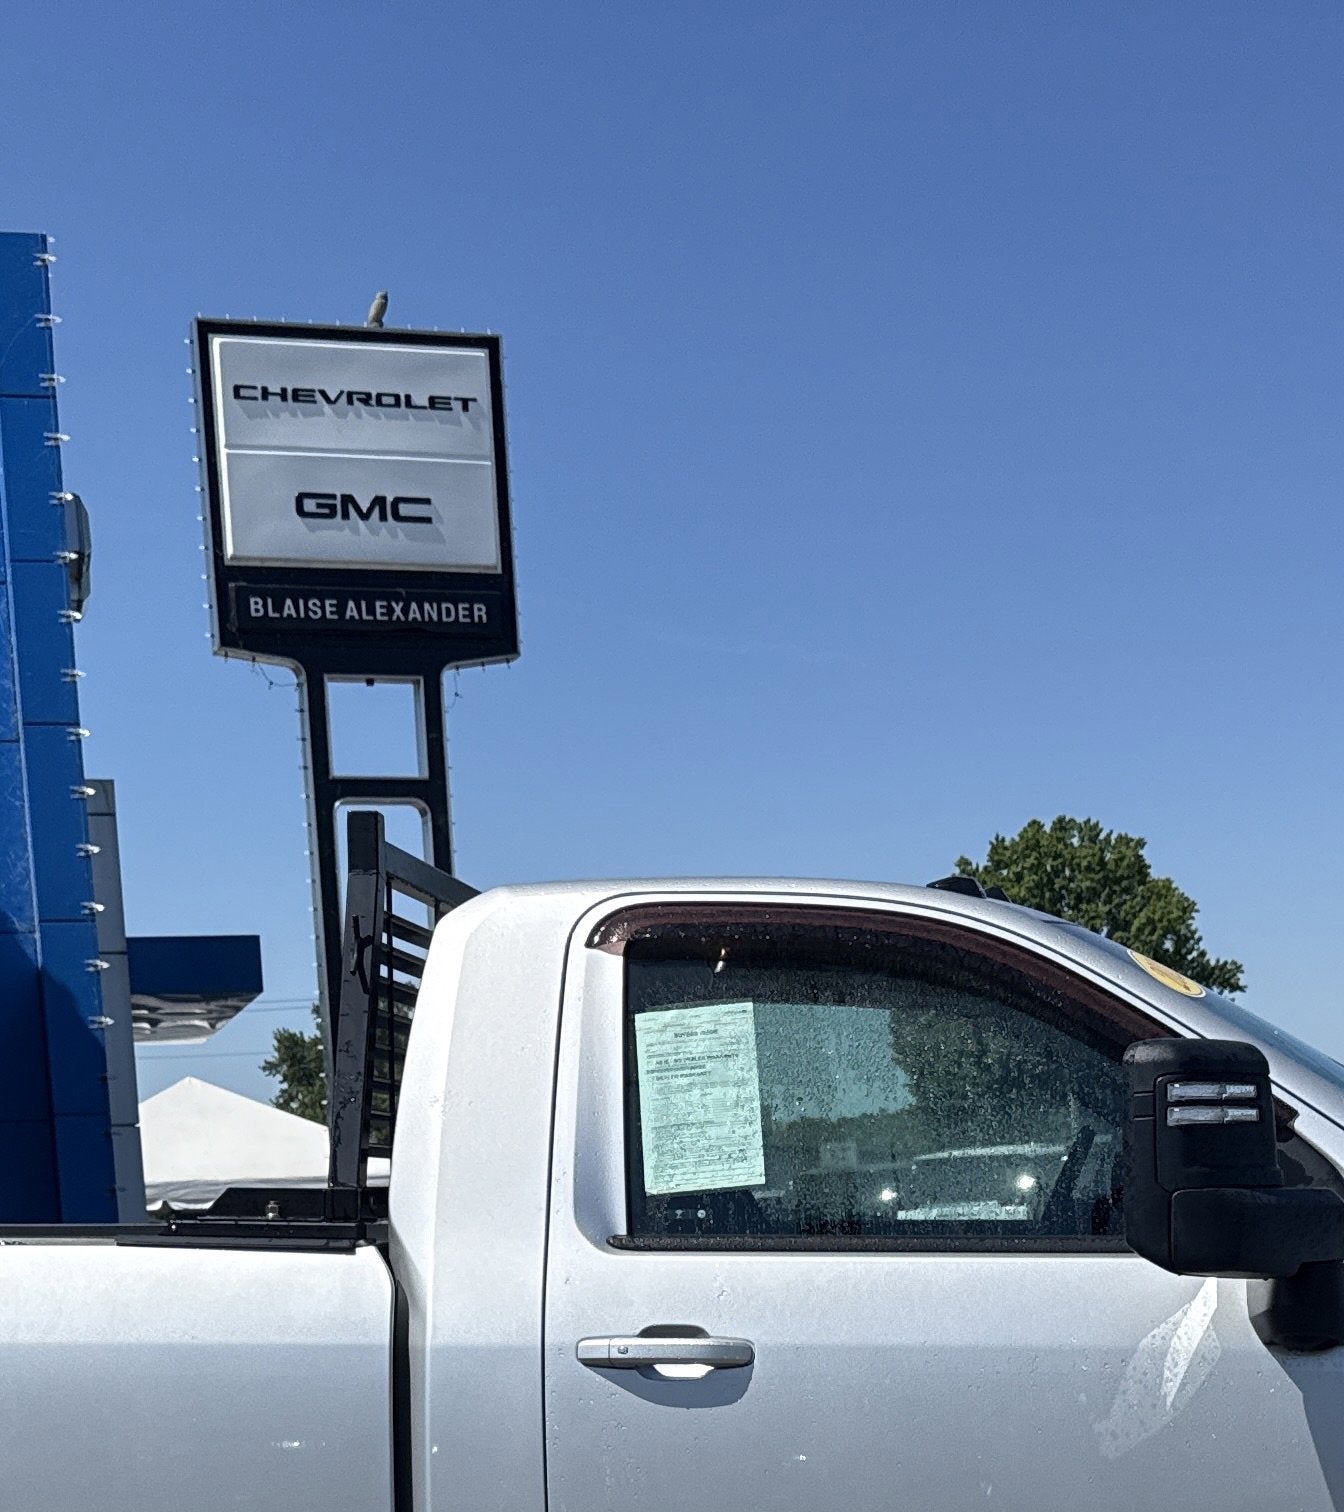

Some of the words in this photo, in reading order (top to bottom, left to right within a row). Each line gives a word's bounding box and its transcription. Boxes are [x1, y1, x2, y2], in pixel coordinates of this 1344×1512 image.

[233, 384, 478, 412] CHEVROLET
[295, 492, 433, 524] GMC
[249, 596, 339, 620] BLAISE
[345, 598, 488, 623] ALEXANDER
